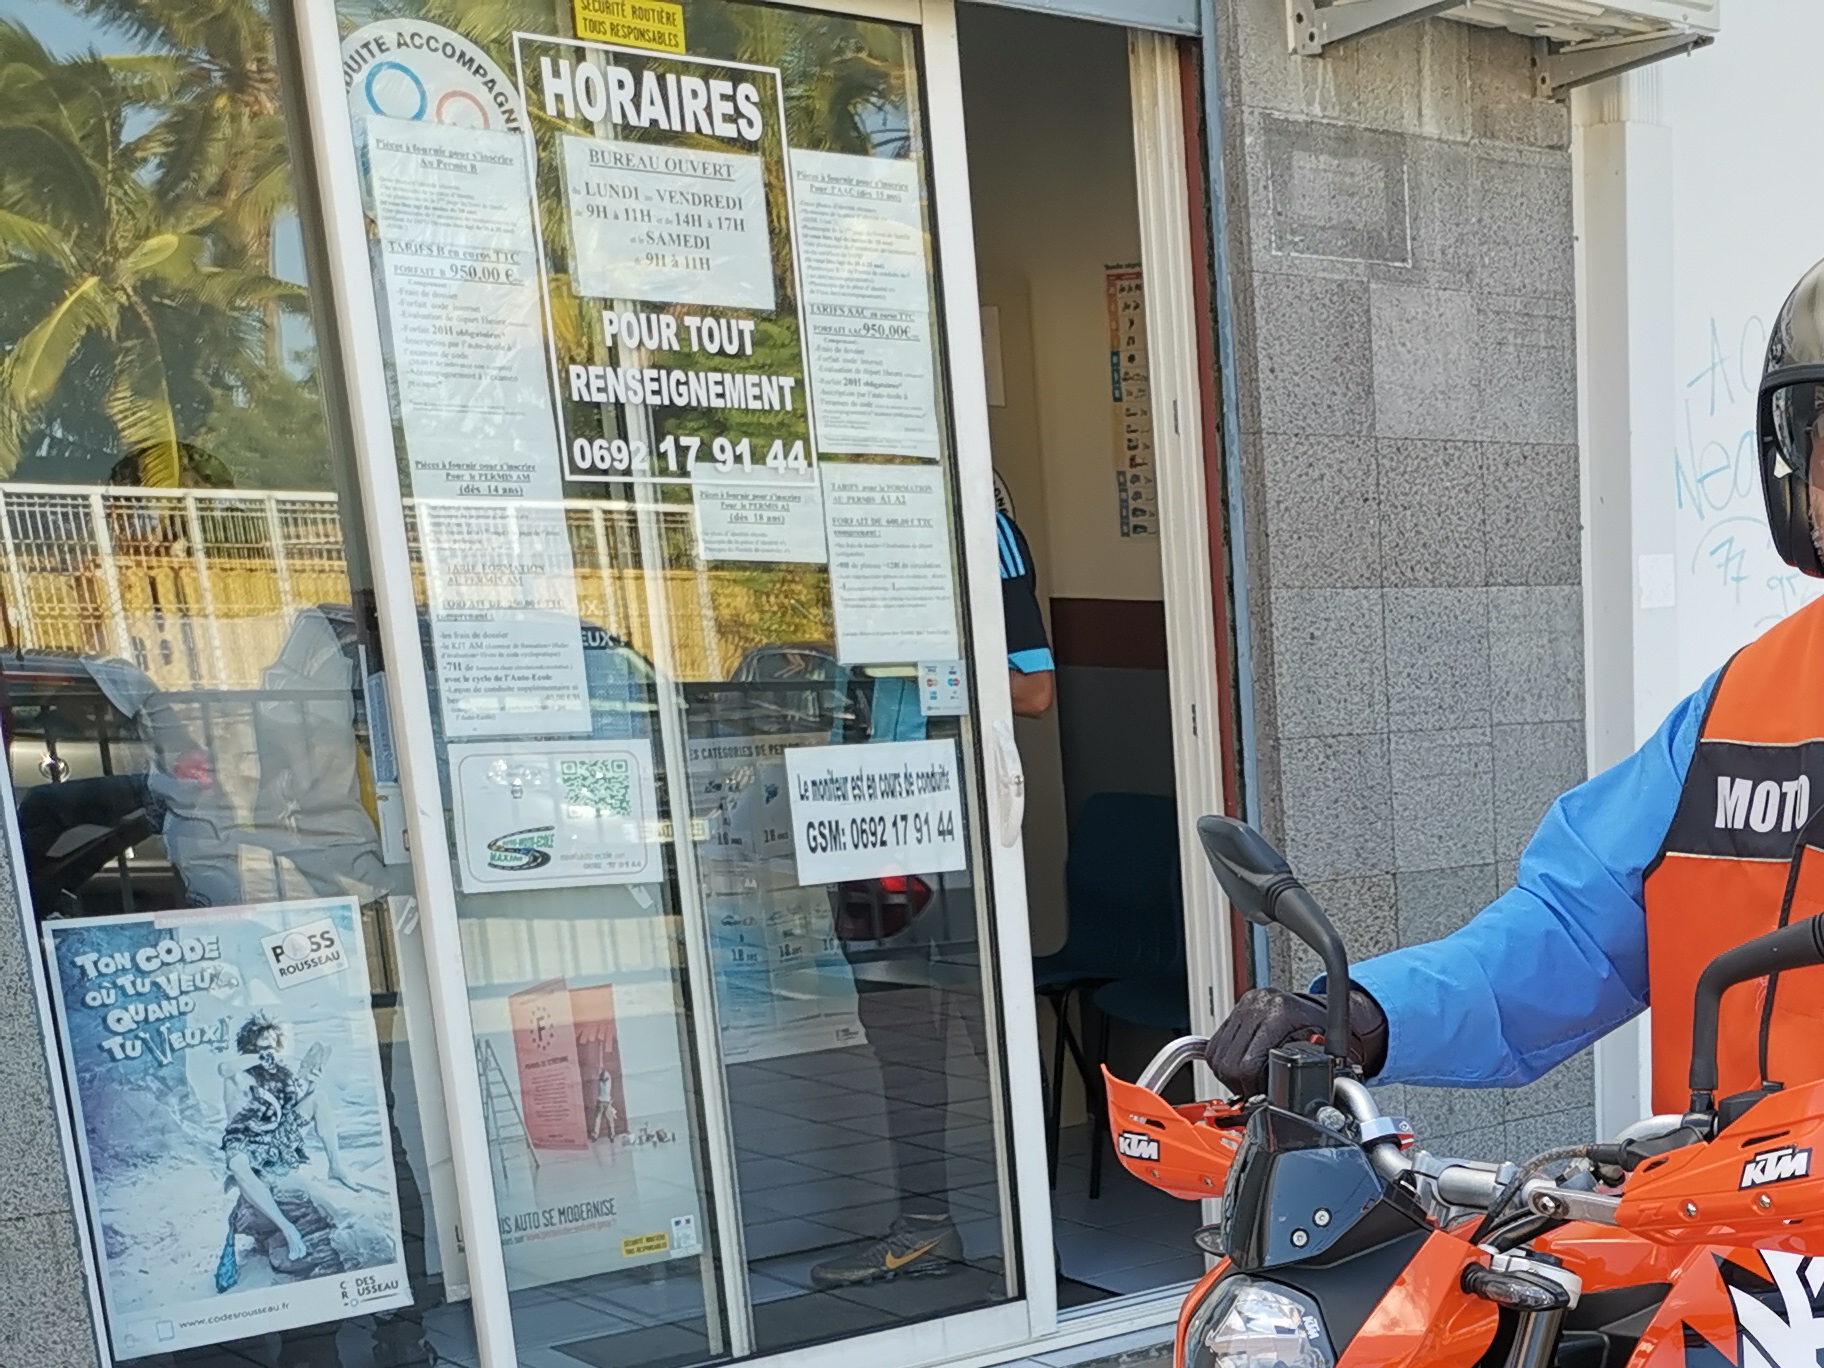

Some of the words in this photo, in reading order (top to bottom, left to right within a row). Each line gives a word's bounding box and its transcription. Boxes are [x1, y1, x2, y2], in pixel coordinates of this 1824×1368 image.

[631, 0, 677, 27] ROUTIÈRE
[582, 17, 607, 35] TOUS
[610, 22, 679, 48] RESPONSABLES
[541, 57, 763, 141] HORAIRES
[589, 149, 660, 170] BUREAU
[665, 157, 735, 178] OUVERT
[585, 182, 639, 201] LUNDI
[656, 189, 743, 211] VENDREDI
[586, 204, 608, 219] 9H
[624, 208, 651, 223] 11H
[675, 212, 702, 228] 14H
[717, 216, 746, 232] 17H
[645, 230, 711, 250] SAMEDI
[646, 252, 666, 268] 9H
[672, 254, 679, 268] à
[685, 256, 711, 271] 11H
[602, 311, 680, 350] POUR
[684, 316, 755, 356] TOUT
[569, 365, 795, 411] RENSEIGNEMENT
[573, 438, 650, 470] 0692
[659, 435, 701, 472] 17
[712, 437, 751, 473] 91
[766, 439, 808, 475] 44
[487, 484, 499, 494] 14
[755, 744, 767, 757] DE
[797, 774, 809, 801] Le
[811, 768, 848, 802] moniteur
[851, 766, 865, 801] est
[866, 773, 878, 801] en
[879, 771, 902, 799] cours
[904, 763, 915, 799] de
[916, 763, 951, 794] conduite
[1715, 774, 1810, 833] MOTO
[807, 819, 847, 853] GSM:
[850, 815, 887, 850] 0692
[892, 814, 908, 846] 17
[914, 811, 931, 844] 91
[937, 810, 955, 842] 44
[75, 952, 131, 979] TON
[136, 936, 221, 972] CODE
[279, 951, 341, 978] ROUSSEAU
[85, 983, 116, 1007] OÙ
[116, 975, 150, 996] TU
[105, 997, 196, 1033] QUAND
[536, 1016, 546, 1042] F
[102, 1036, 143, 1060] TU
[1119, 1132, 1158, 1160] KTM
[1741, 1148, 1809, 1188] KTM
[514, 1211, 541, 1233] AUTO
[542, 1207, 557, 1228] SE
[558, 1198, 617, 1225] MODERNISE
[179, 1302, 290, 1329] www.codesrousseau.fr
